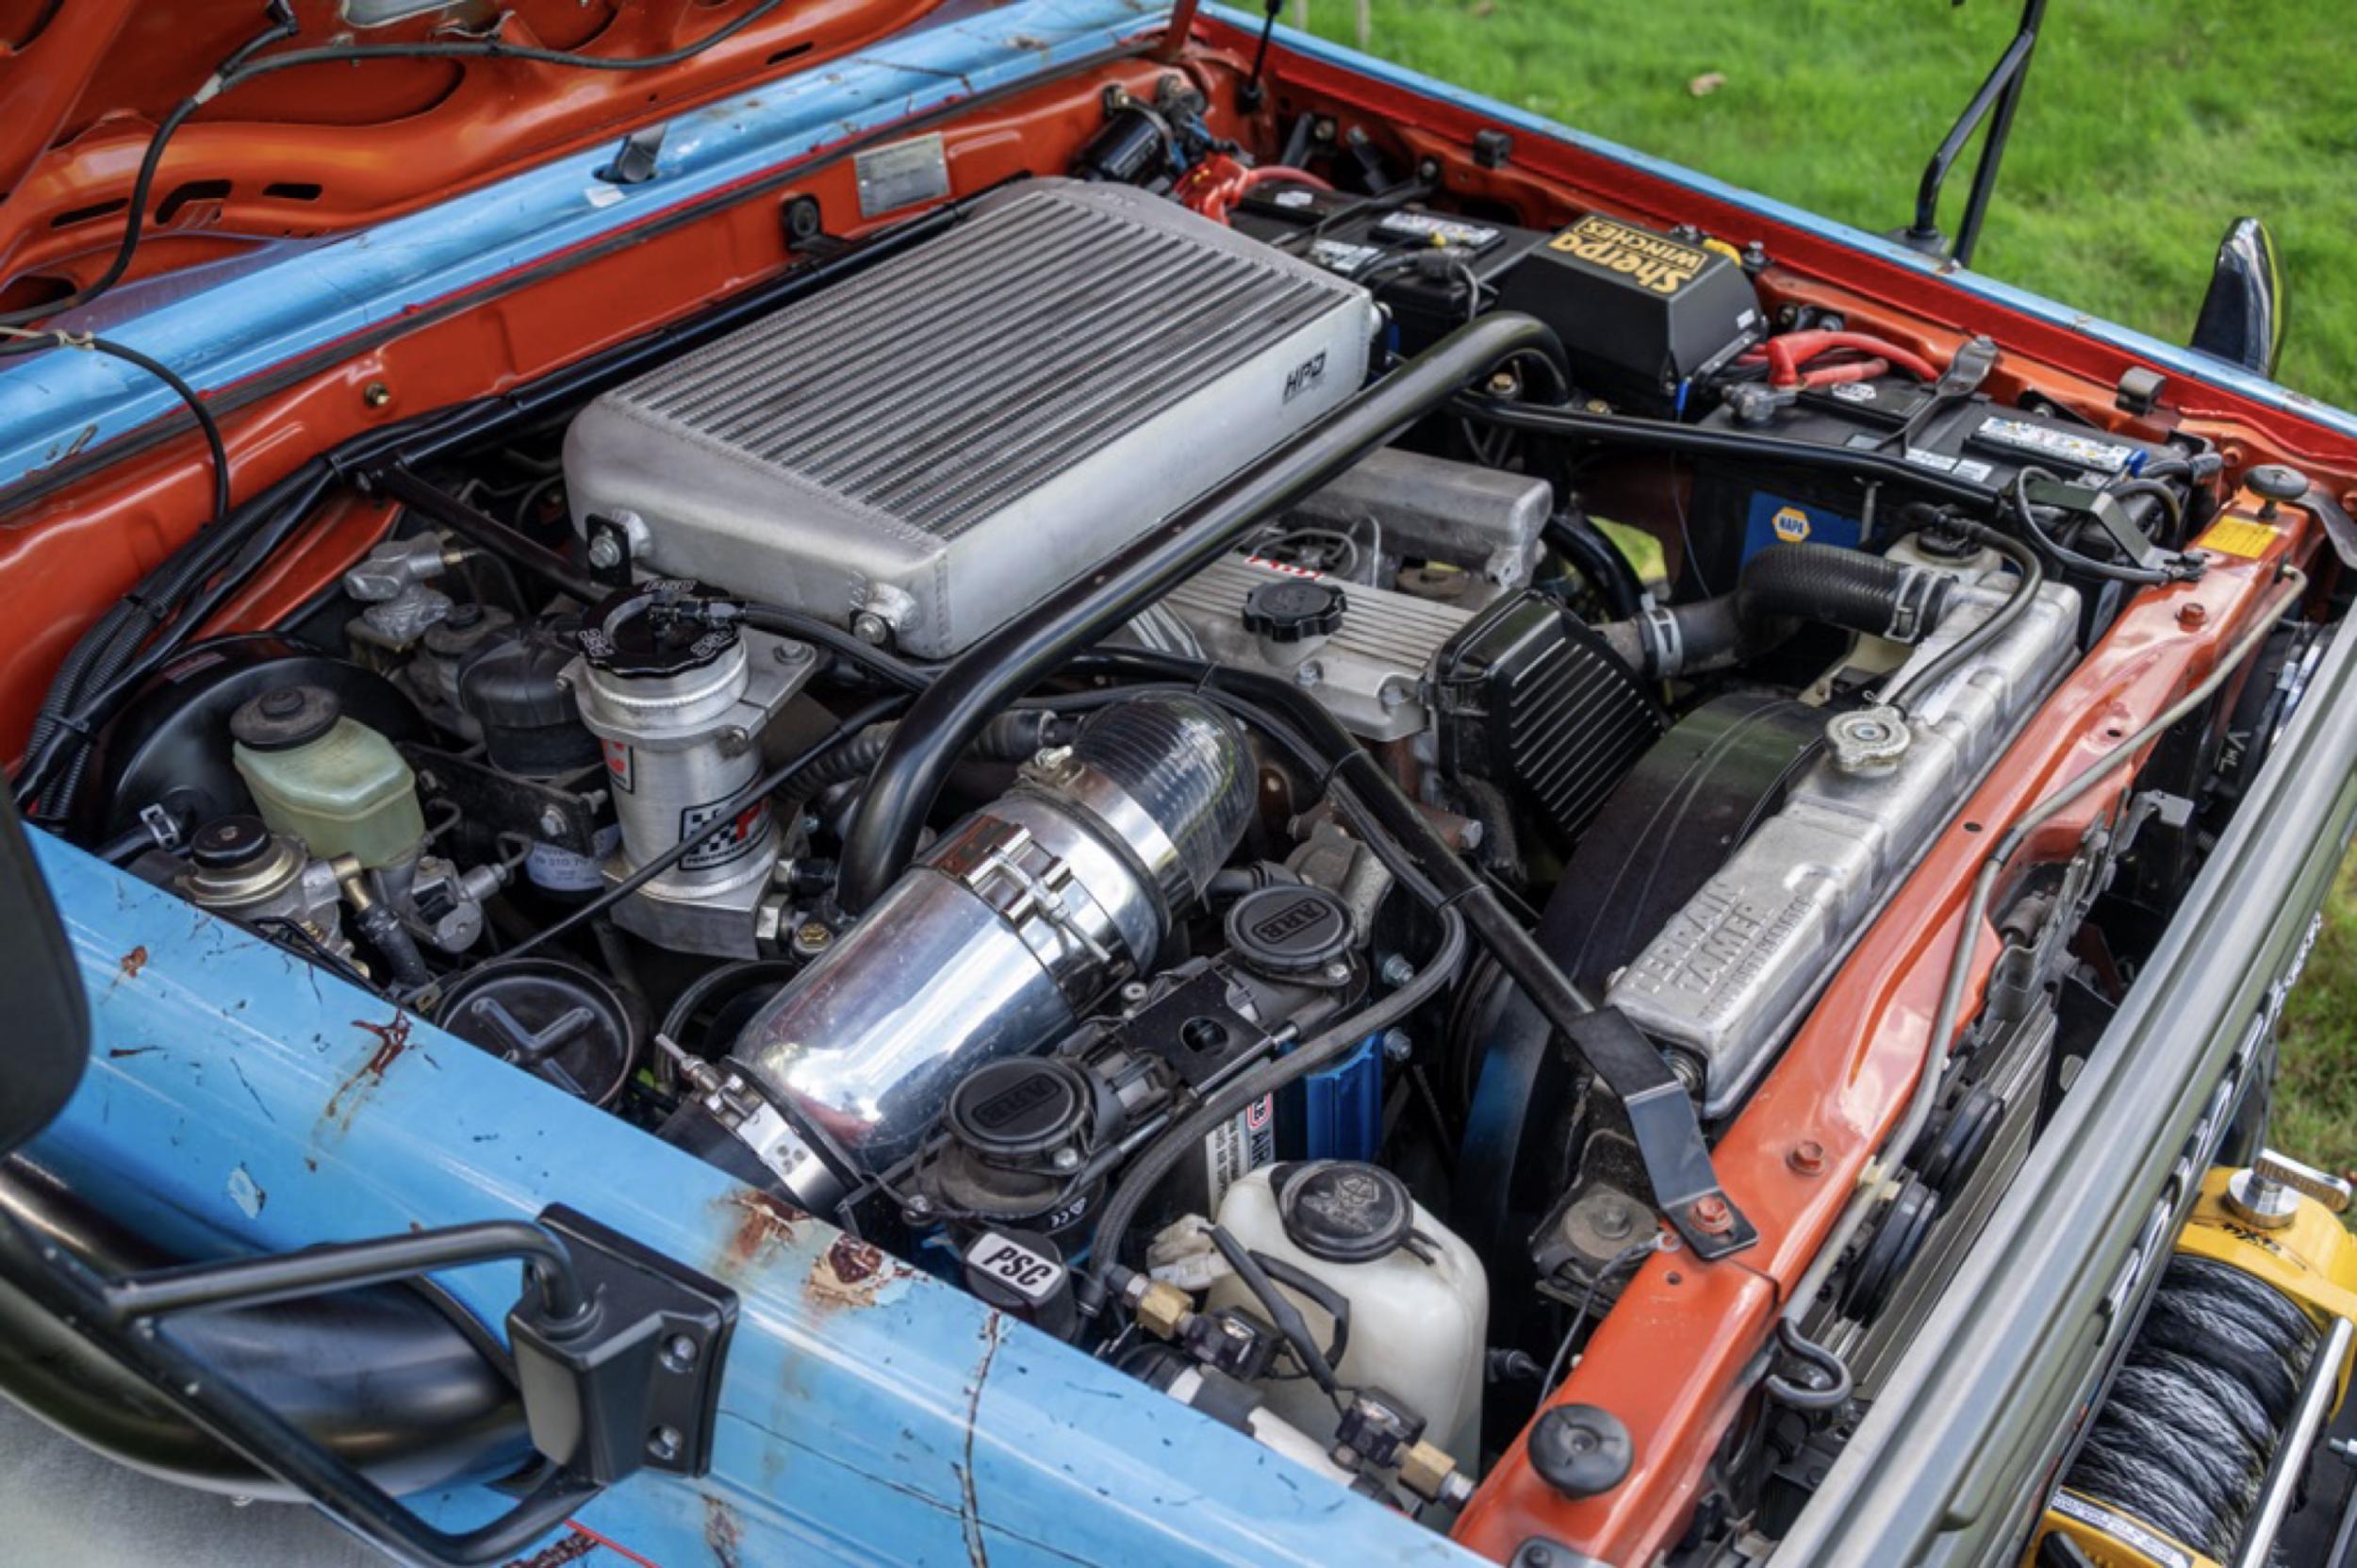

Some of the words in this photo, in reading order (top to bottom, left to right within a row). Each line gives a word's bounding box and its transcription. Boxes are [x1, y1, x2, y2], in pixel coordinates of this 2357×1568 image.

[1284, 351, 1327, 397] HPD
[1778, 516, 1804, 535] NAPA
[1261, 902, 1320, 938] ARB
[1672, 901, 1777, 994] TAMER
[980, 1081, 1049, 1123] ARB
[981, 1246, 1053, 1285] PSC
